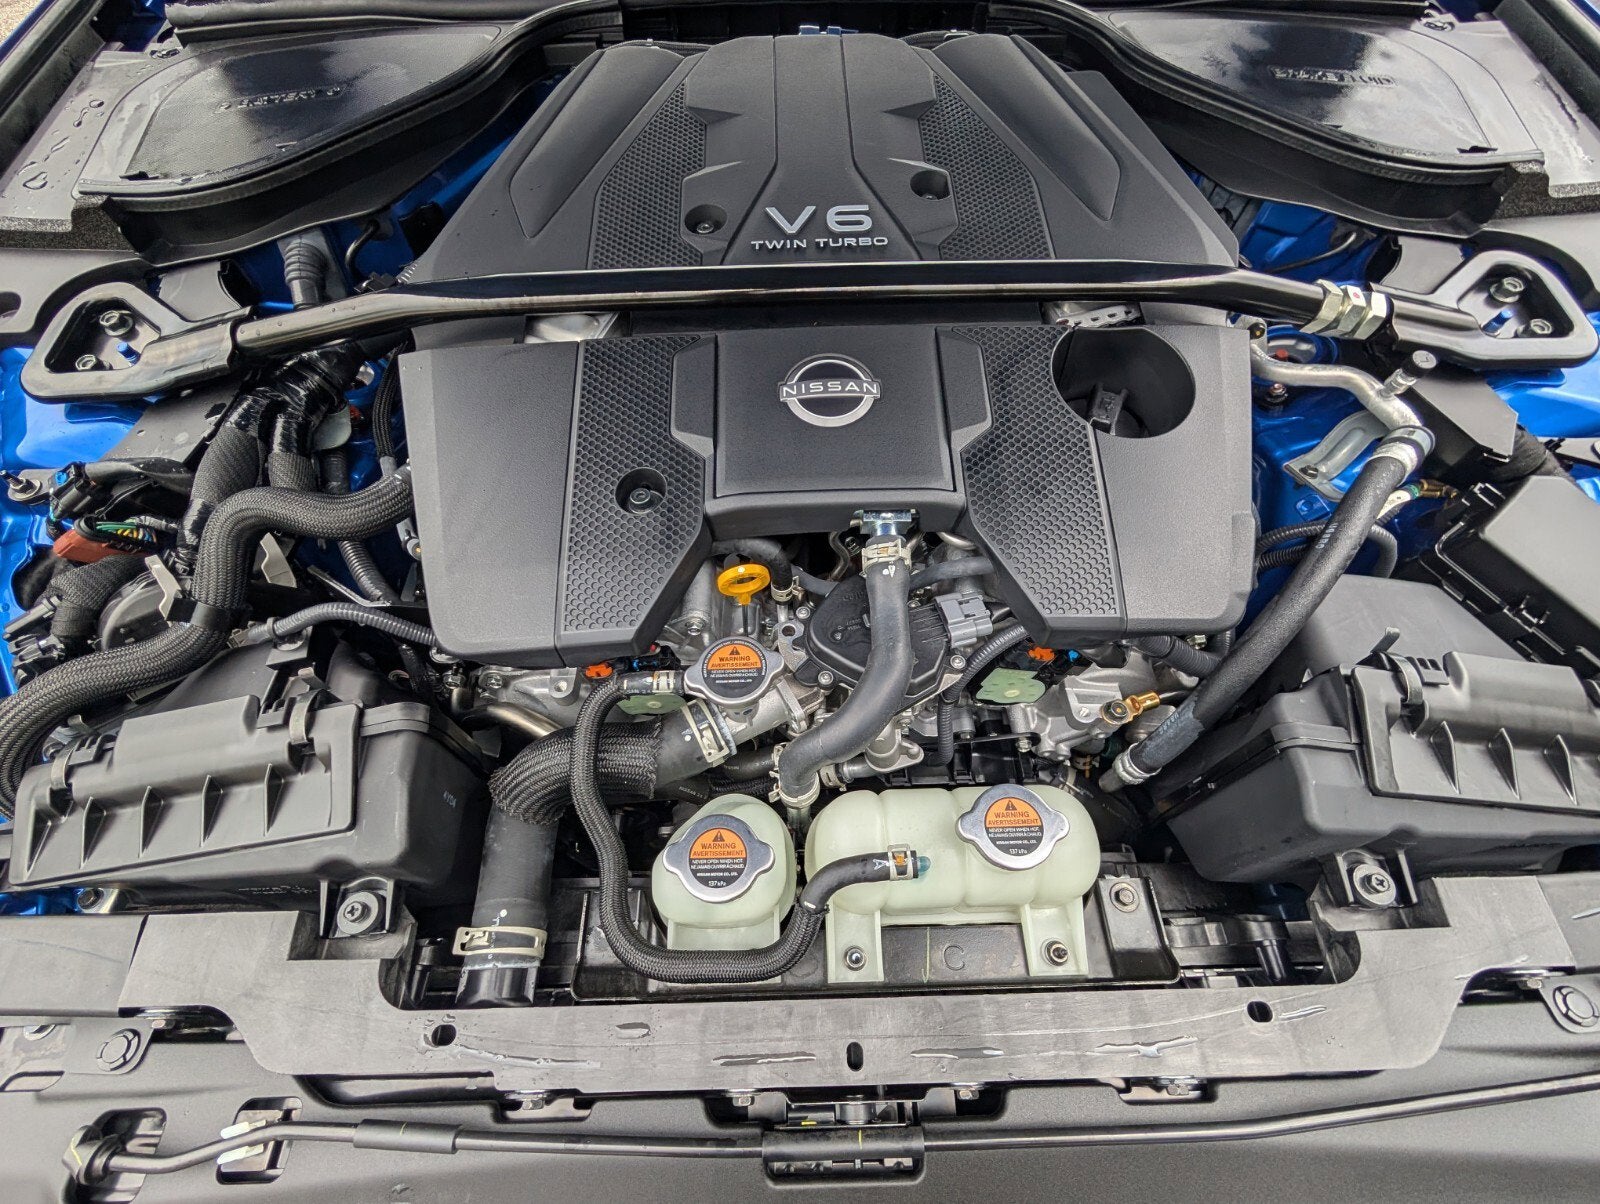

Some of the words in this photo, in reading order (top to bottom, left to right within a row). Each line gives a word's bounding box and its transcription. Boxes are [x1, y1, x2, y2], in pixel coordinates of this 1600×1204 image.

[765, 204, 873, 234] V6
[751, 239, 807, 250] TWIN
[815, 236, 889, 248] TURBO
[782, 381, 878, 398] NISSAN
[943, 945, 966, 971] C
